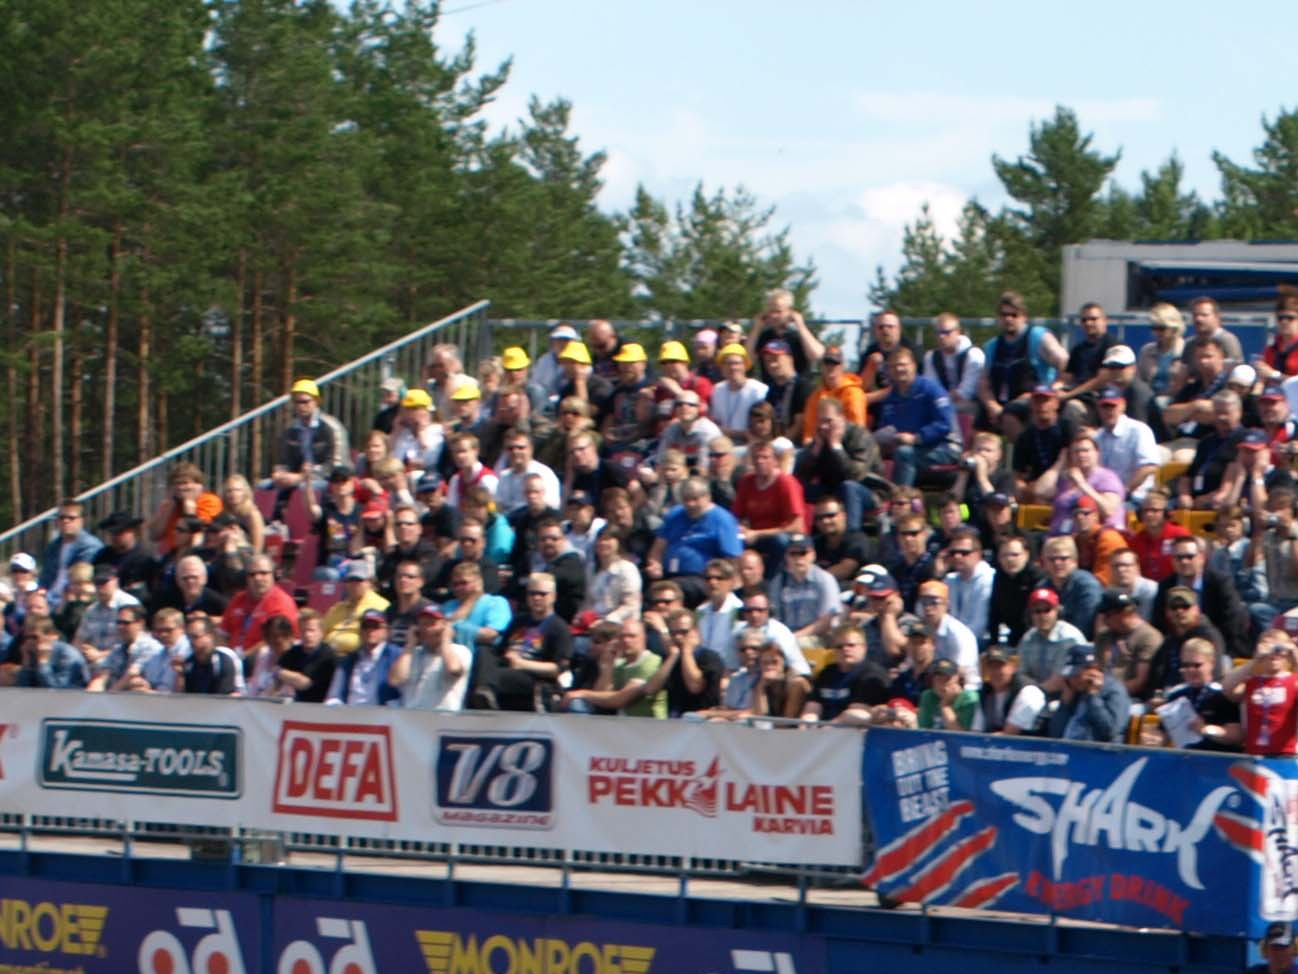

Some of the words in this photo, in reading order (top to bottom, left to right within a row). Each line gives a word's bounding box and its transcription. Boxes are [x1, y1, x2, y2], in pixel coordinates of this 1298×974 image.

[286, 737, 385, 804] DEFA
[446, 740, 546, 807] V8
[589, 755, 696, 777] KULJETUS
[726, 782, 834, 816] LAINE
[752, 815, 834, 836] KARVIA
[988, 756, 1240, 890] SHARK
[1110, 871, 1191, 926] DRINK
